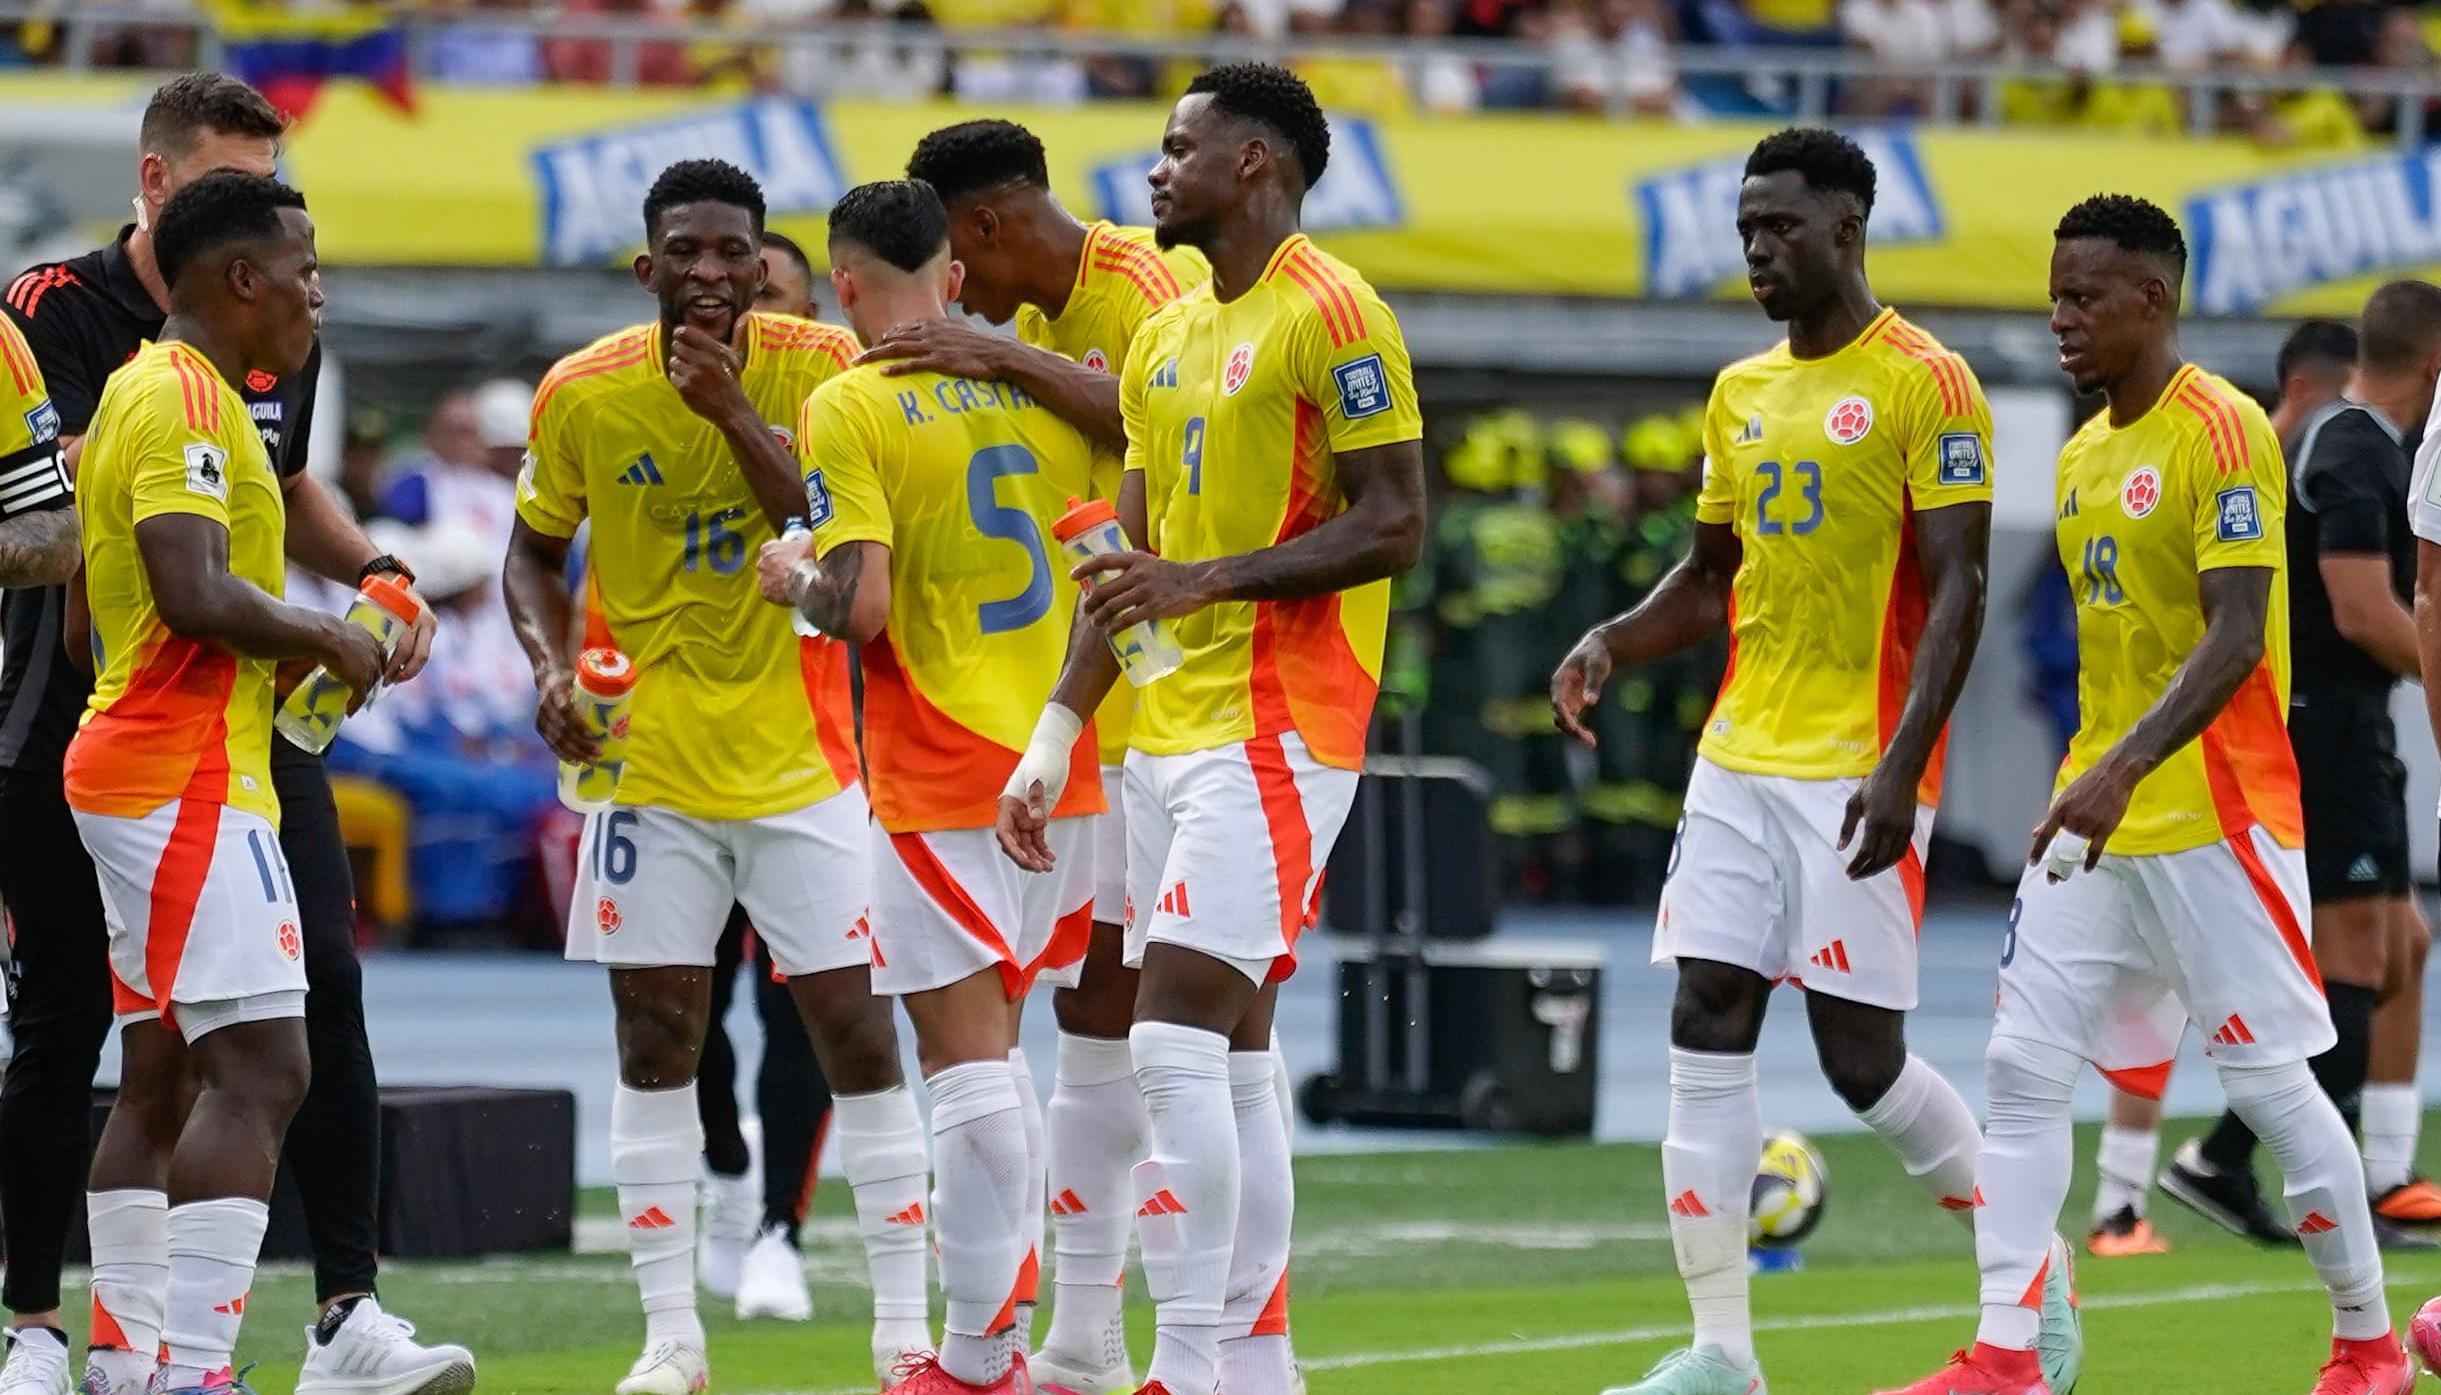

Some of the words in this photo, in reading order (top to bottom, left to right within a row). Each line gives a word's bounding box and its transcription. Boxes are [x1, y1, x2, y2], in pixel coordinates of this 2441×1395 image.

[2202, 152, 2441, 313] AGUIL
[897, 390, 934, 425] K.
[1183, 416, 1205, 496] 9
[1755, 462, 1824, 535] 23
[684, 508, 745, 574] 16
[967, 445, 1054, 635] 5
[2084, 536, 2123, 605] 18
[592, 811, 638, 885] 16
